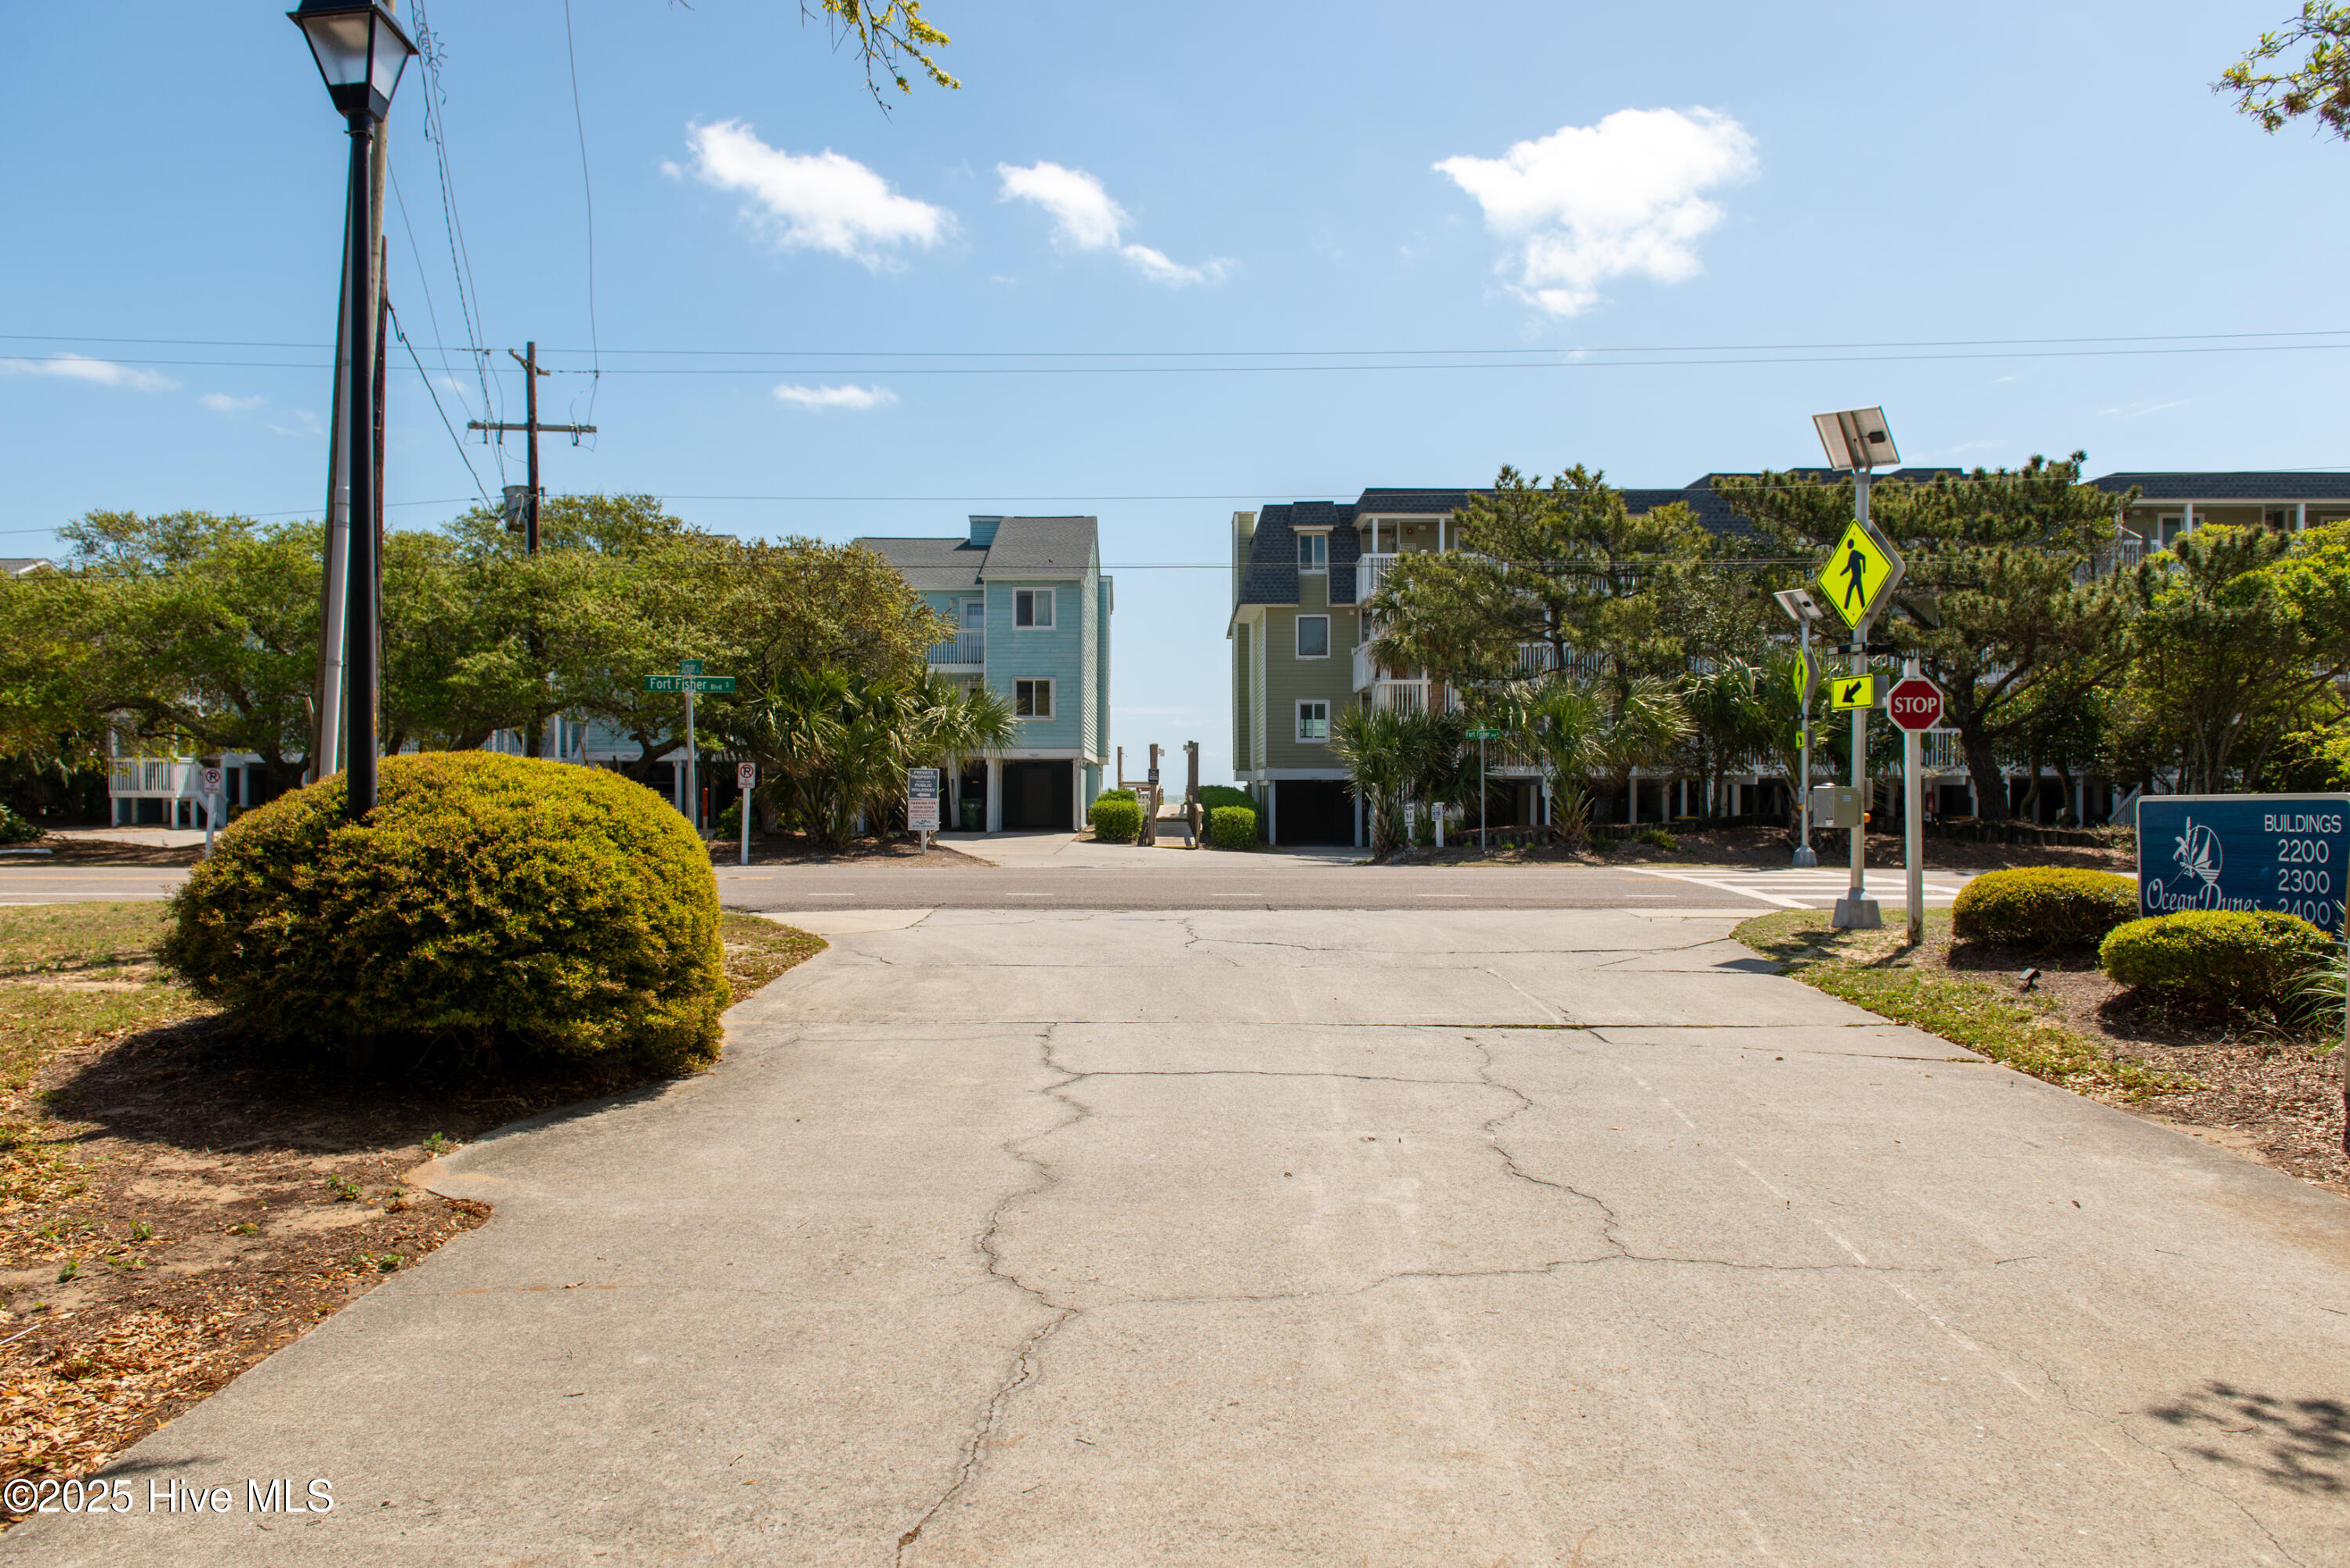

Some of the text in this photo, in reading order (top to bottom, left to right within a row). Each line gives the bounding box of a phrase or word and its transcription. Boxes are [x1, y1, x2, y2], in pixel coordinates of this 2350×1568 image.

[650, 677, 671, 689] Fort
[675, 677, 707, 690] Fisher
[1894, 696, 1938, 714] STOP
[2264, 814, 2342, 833] BUILDINGS
[2278, 838, 2330, 864] 2200
[2146, 878, 2198, 910] Ocean
[2278, 869, 2330, 894] 2300
[2278, 898, 2330, 925] 2400
